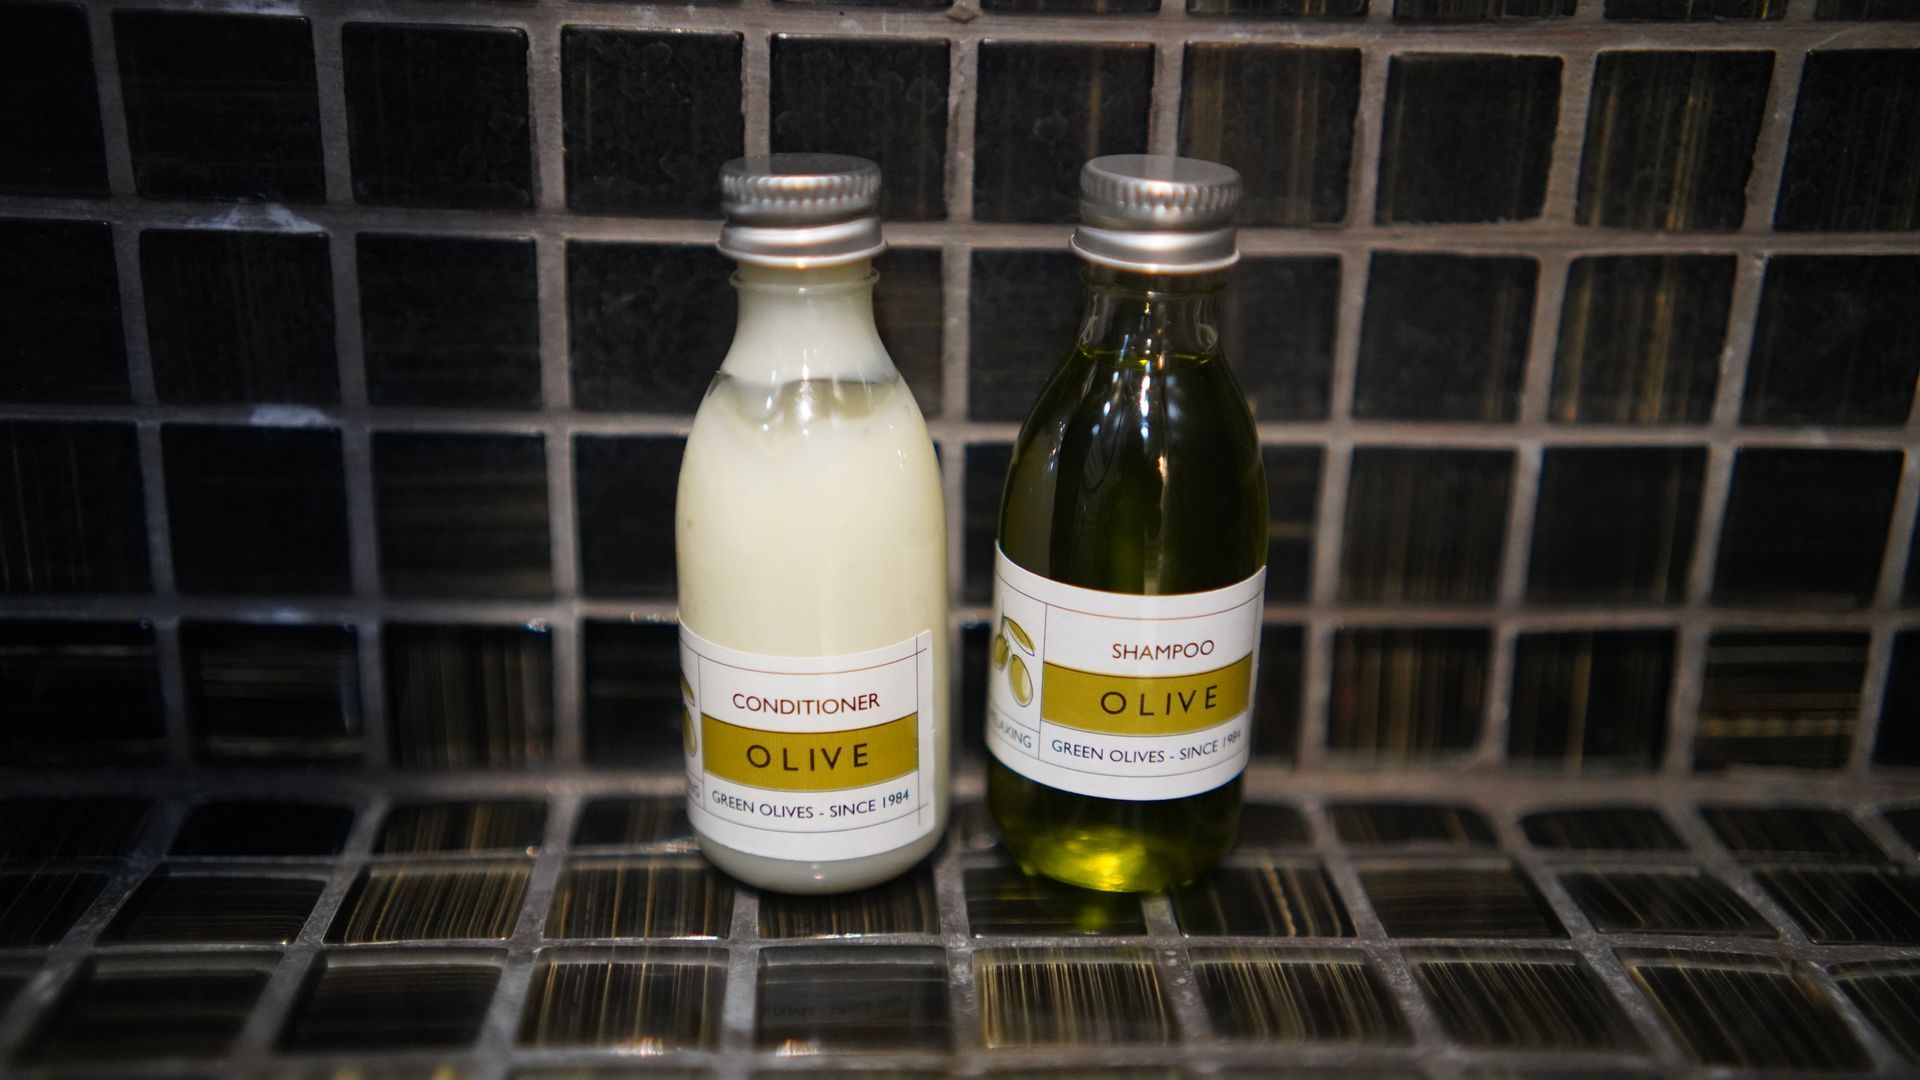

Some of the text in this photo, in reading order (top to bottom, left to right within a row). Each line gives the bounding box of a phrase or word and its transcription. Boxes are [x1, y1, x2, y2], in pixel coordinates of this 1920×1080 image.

[1112, 640, 1215, 660] SHAMPOO
[732, 693, 880, 715] CONDITIONER
[1101, 685, 1218, 716] OLIVE
[746, 743, 868, 771] OLIVE
[1051, 739, 1104, 761] GREEN
[1109, 749, 1165, 763] OLIVES
[1179, 740, 1219, 760] SINCE
[1222, 729, 1241, 749] 1984
[712, 790, 754, 813] GREEN
[759, 803, 813, 818] OLIVES
[829, 802, 876, 818] SINCE
[881, 789, 909, 808] 1984
